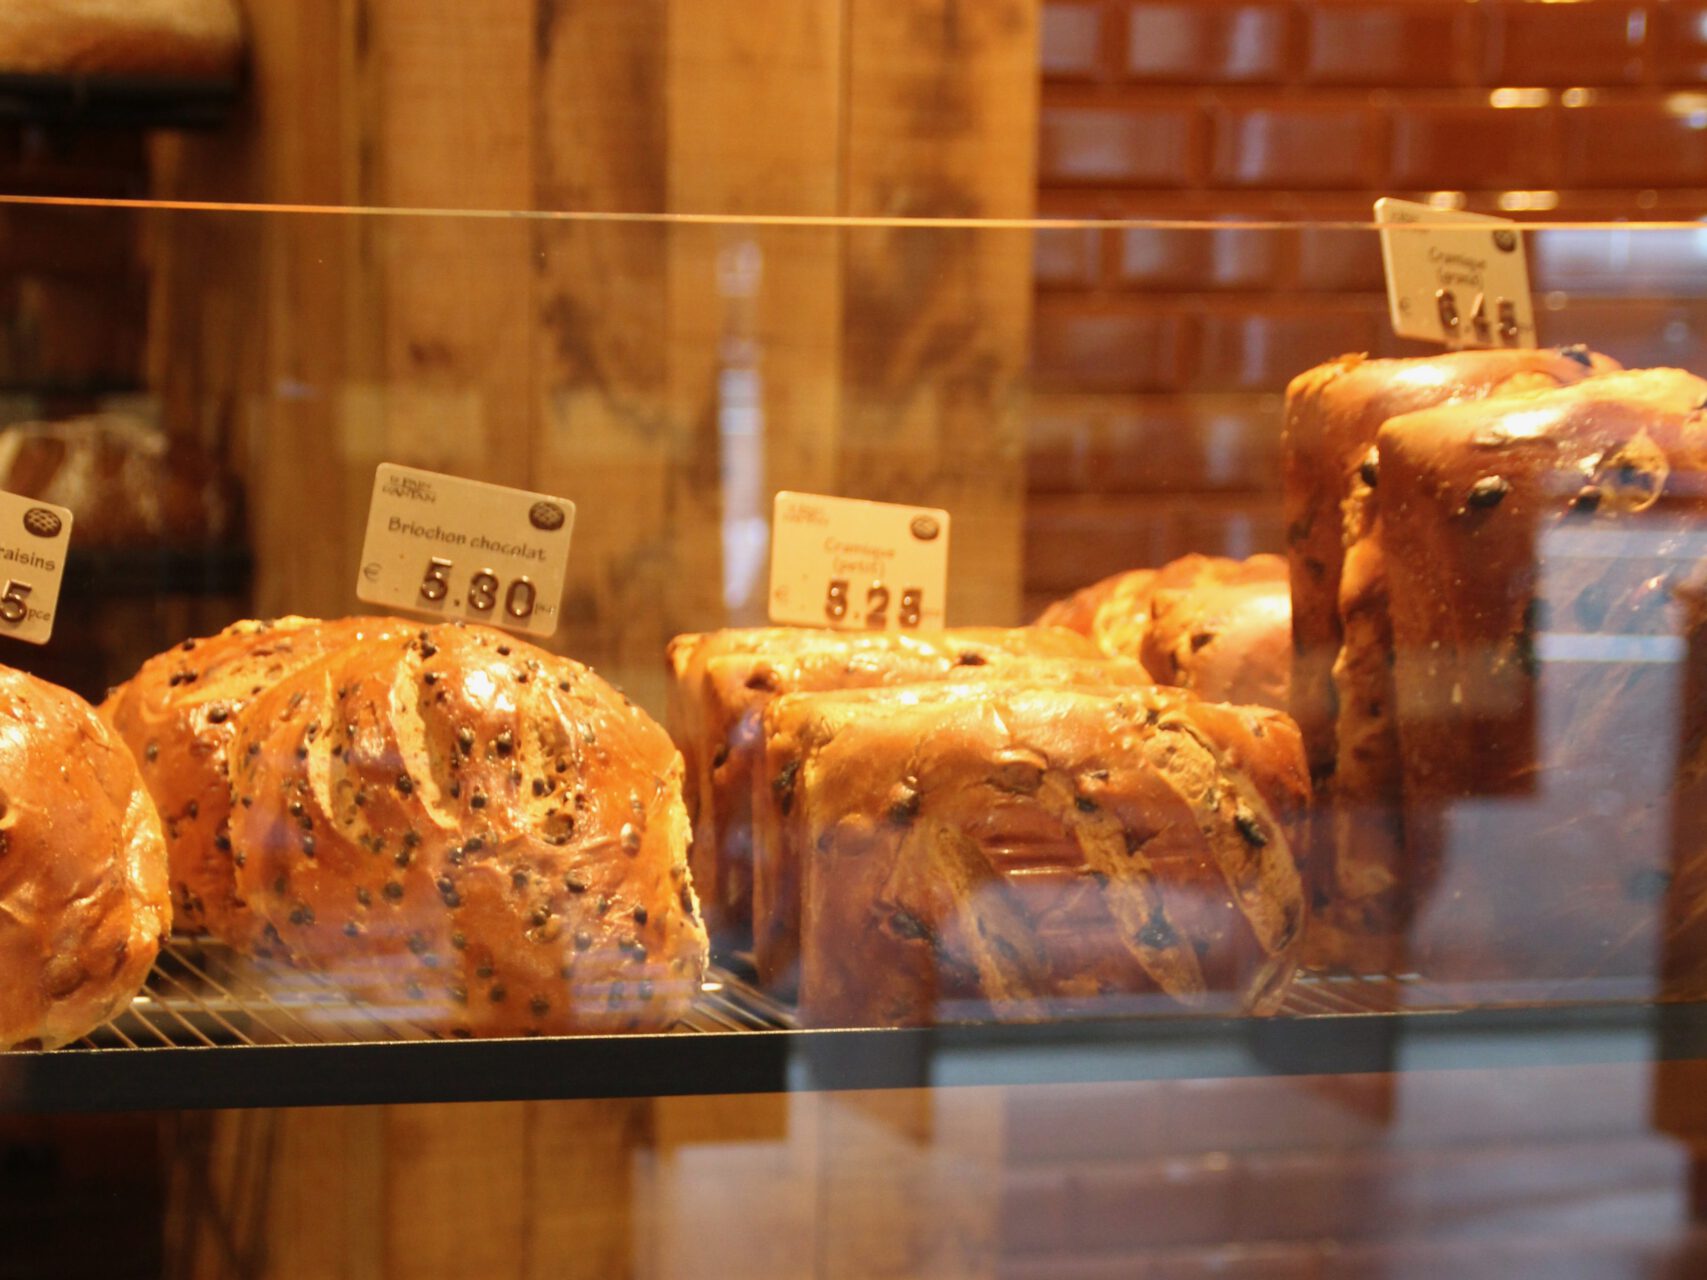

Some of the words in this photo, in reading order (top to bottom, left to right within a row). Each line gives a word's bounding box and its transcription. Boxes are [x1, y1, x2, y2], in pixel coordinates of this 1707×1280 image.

[387, 515, 467, 546] Briochon
[469, 534, 547, 562] chocolat
[27, 607, 52, 622] pce
